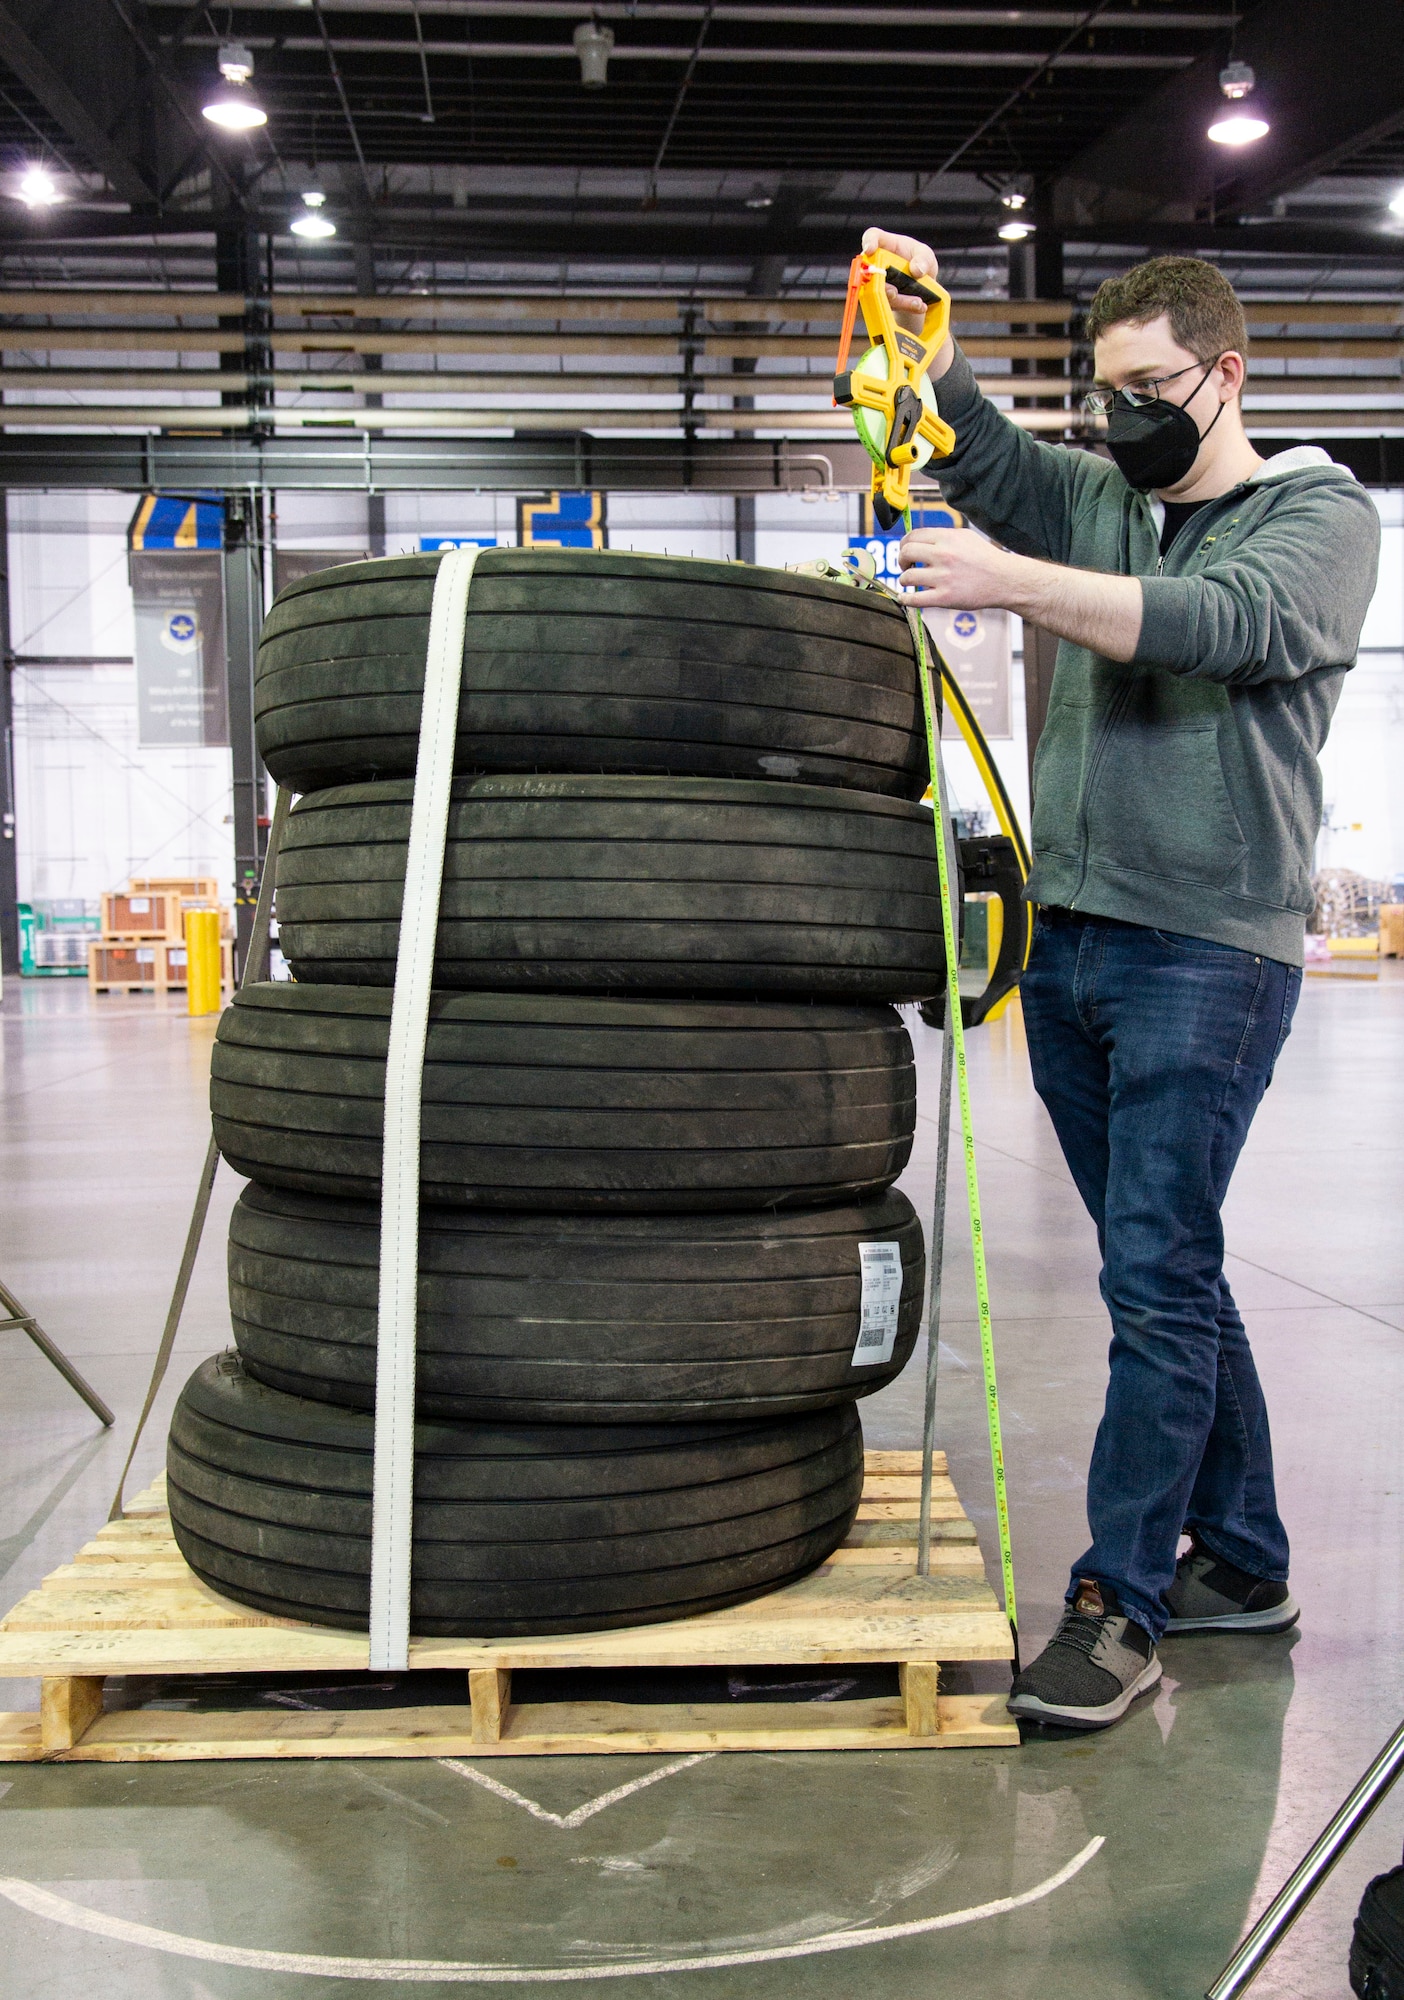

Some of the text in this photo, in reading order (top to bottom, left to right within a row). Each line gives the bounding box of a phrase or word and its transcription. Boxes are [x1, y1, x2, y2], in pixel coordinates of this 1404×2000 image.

[951, 969, 957, 983] 90
[958, 1053, 965, 1066] 80
[966, 1136, 973, 1149] 70
[973, 1219, 981, 1232] 60
[981, 1302, 989, 1315] 50
[988, 1385, 997, 1398] 40
[996, 1468, 1004, 1481] 30
[1004, 1551, 1012, 1564] 20
